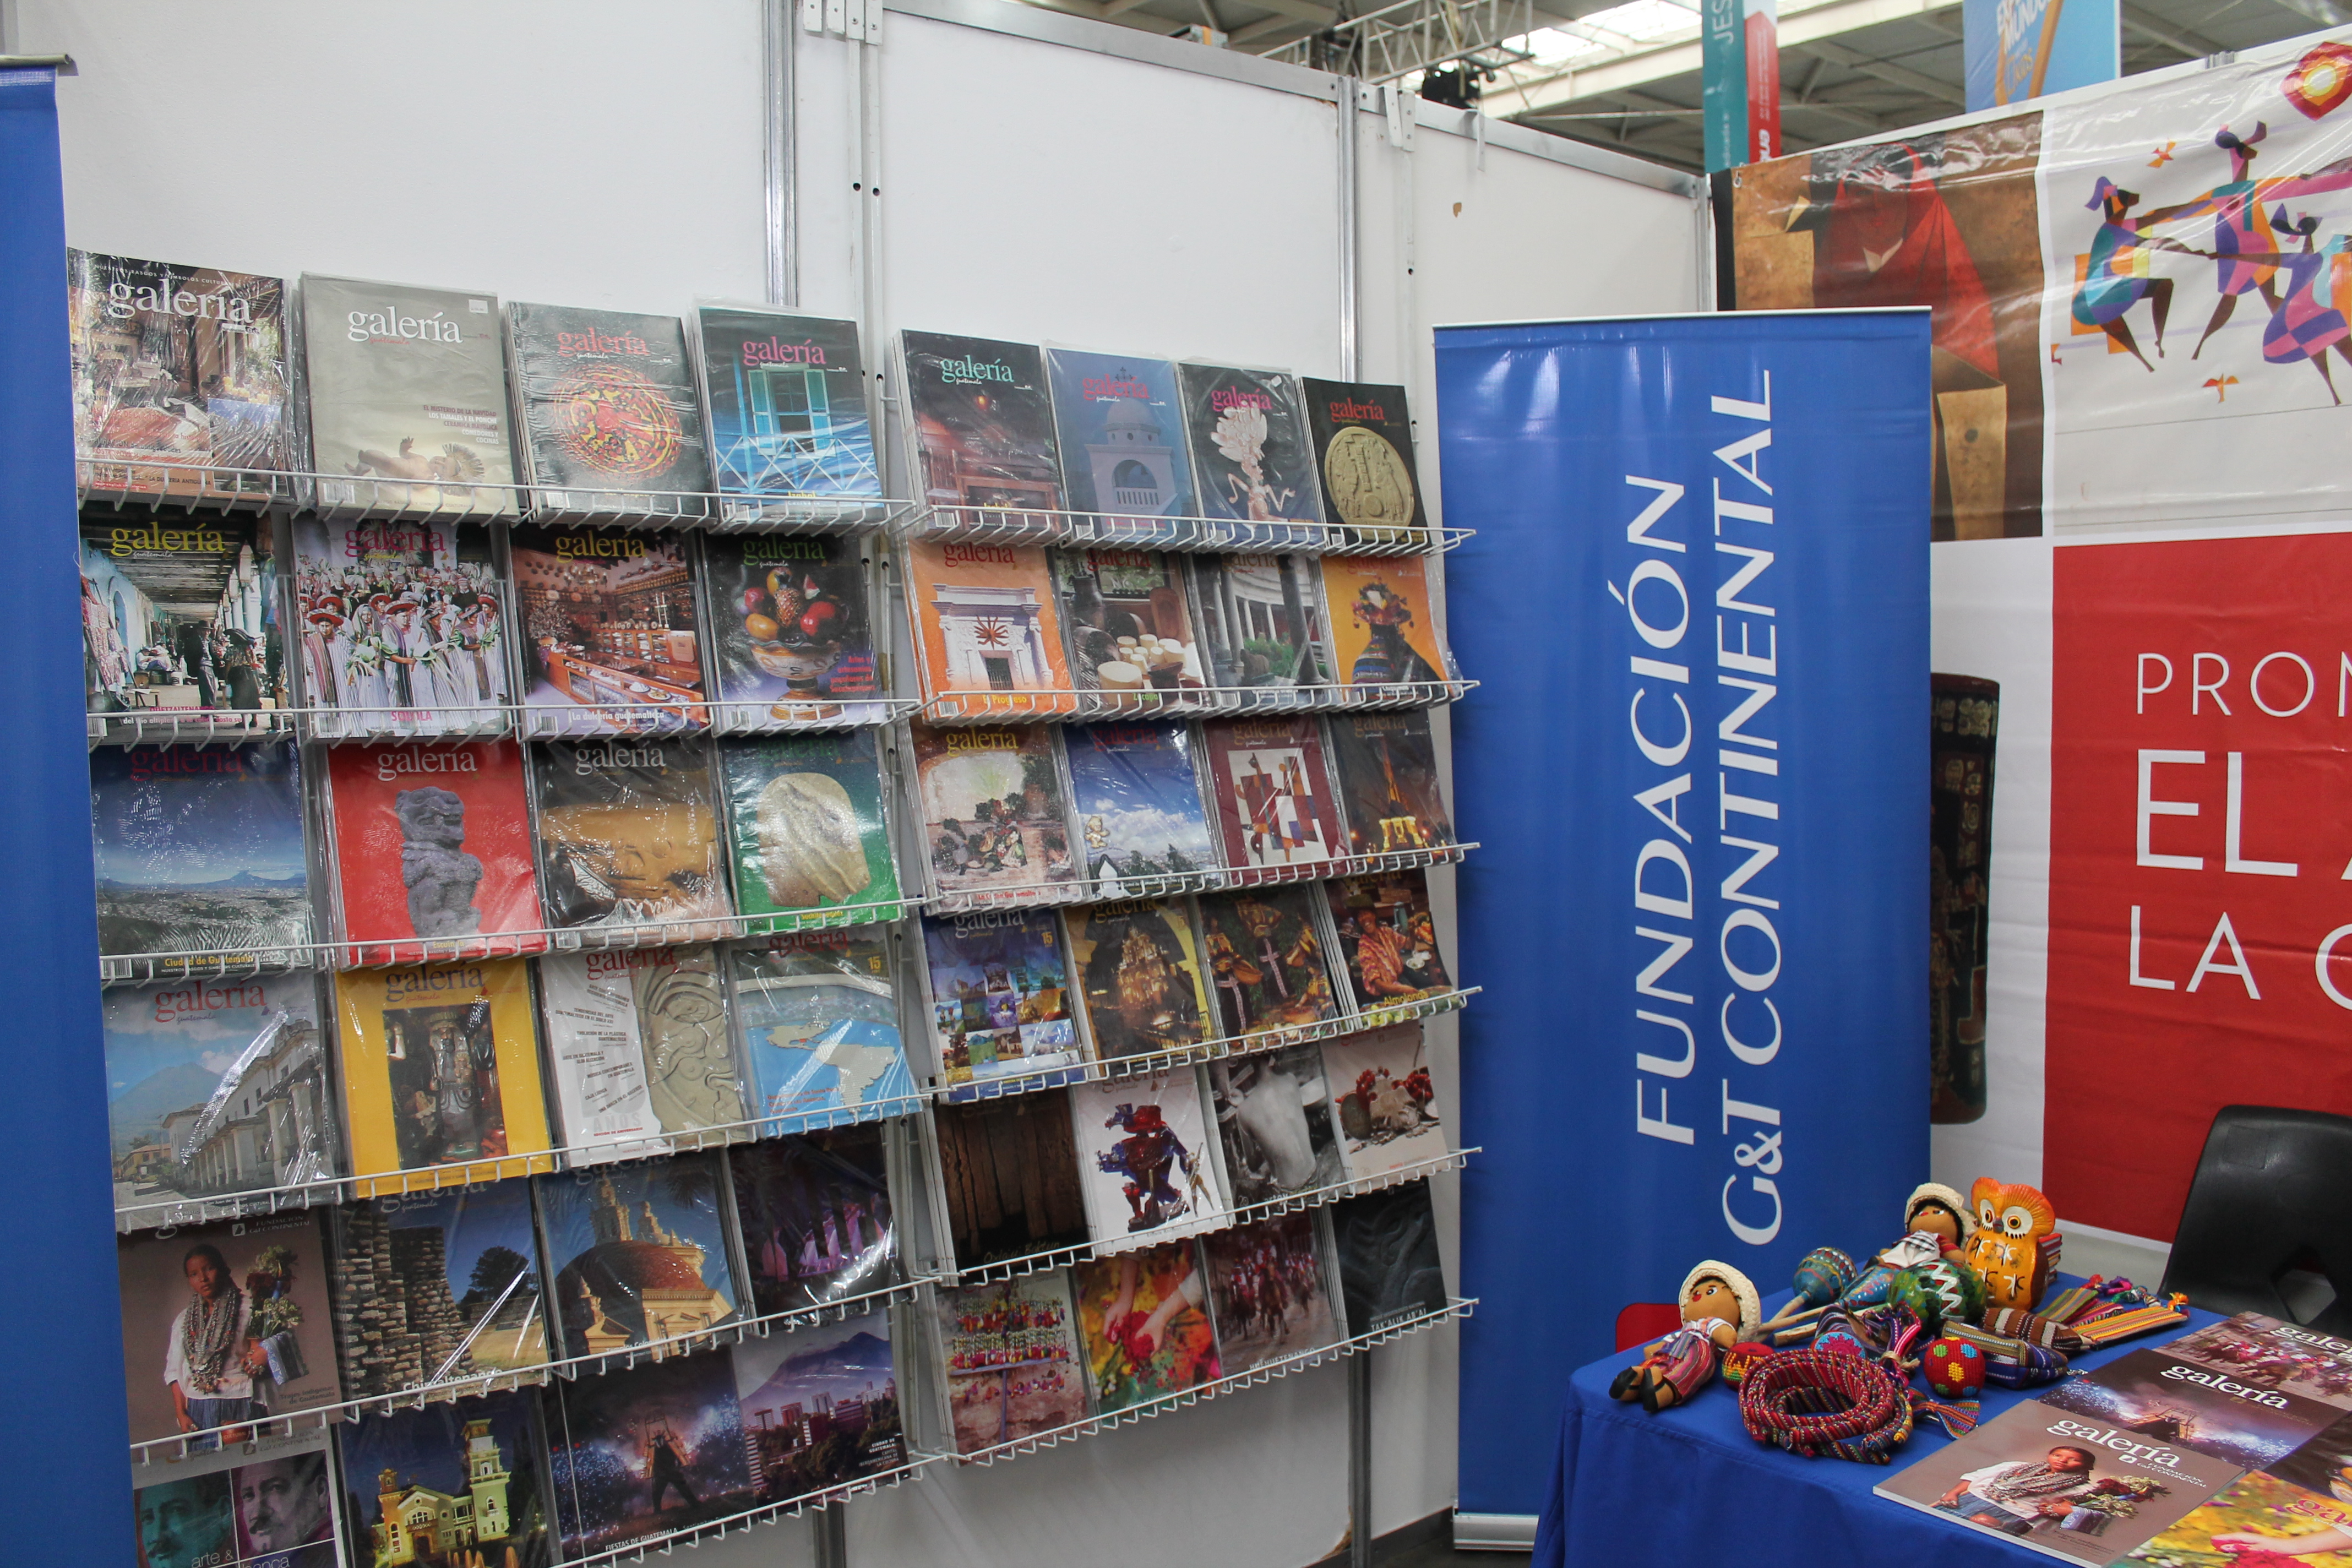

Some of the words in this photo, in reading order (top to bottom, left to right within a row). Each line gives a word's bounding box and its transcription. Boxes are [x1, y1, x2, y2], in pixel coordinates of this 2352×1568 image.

[108, 279, 254, 324] galería
[347, 306, 464, 344] galería
[558, 327, 650, 357] galería
[743, 336, 826, 366] galería
[940, 355, 1015, 383] galería
[1082, 373, 1150, 401] galería
[1212, 385, 1272, 412] galería
[440, 413, 462, 422] TAMALES
[476, 416, 497, 424] PONCHE
[1330, 396, 1385, 423] galería
[110, 521, 226, 557] galería
[345, 523, 447, 558] galería
[556, 530, 647, 564] galería
[743, 534, 826, 567] galería
[992, 694, 1027, 706] Progeso
[1133, 693, 1159, 702] Zcapa
[2136, 650, 2352, 718] PRO
[572, 712, 580, 721] La
[1711, 369, 1782, 1065] CONTINENTAL
[946, 726, 1019, 758] galería
[1092, 723, 1159, 753] galería
[130, 743, 244, 782] galería
[378, 745, 477, 782] galería
[575, 740, 667, 776] galería
[1608, 474, 1695, 1146] FUNDACIÓN
[2136, 748, 2298, 878] EL
[1041, 931, 1053, 945] 15
[2129, 905, 2261, 1001] LA
[165, 956, 194, 967] Ciudd
[197, 955, 207, 965] de
[208, 954, 254, 965] Gutemala
[868, 956, 881, 971] 15
[385, 961, 486, 1003] galería
[155, 979, 268, 1023] galería
[176, 1013, 216, 1025] guatemala
[1722, 1078, 1783, 1245] G&T
[2159, 1365, 2289, 1410] galería
[2046, 1419, 2181, 1468] galería
[640, 1527, 678, 1543] GUATEMALA
[191, 1551, 221, 1568] arte
